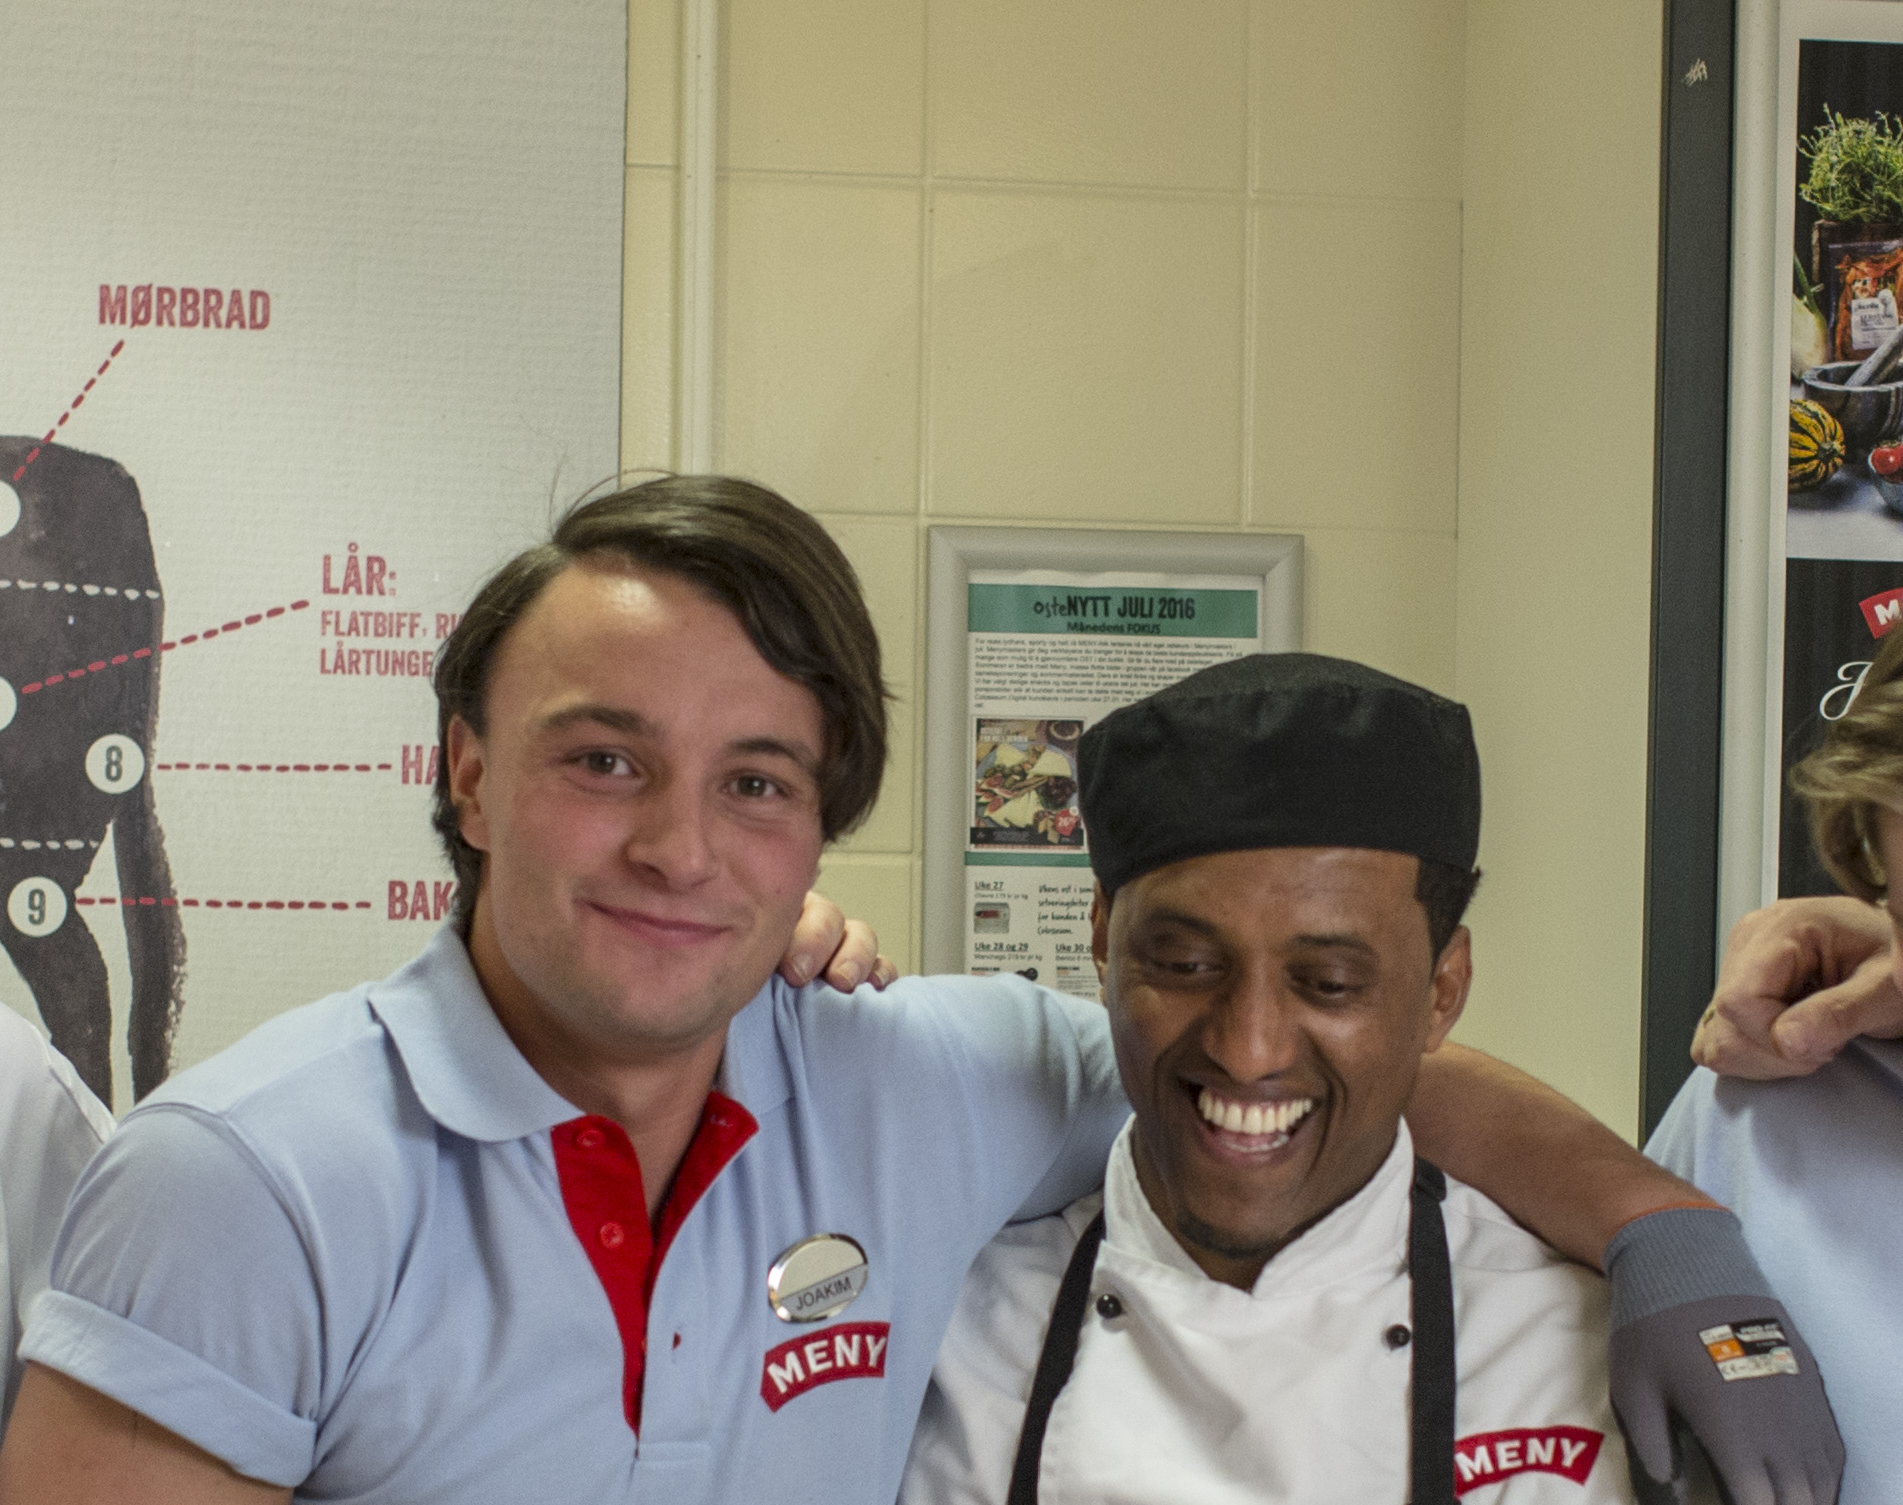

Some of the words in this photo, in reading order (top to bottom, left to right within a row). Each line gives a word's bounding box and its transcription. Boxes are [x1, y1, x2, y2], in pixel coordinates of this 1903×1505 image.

[98, 283, 272, 331] MØRBRAD
[322, 541, 397, 597] LÅR:
[320, 609, 428, 639] FLATBIFF,
[1118, 597, 1154, 619] JULI
[1158, 597, 1196, 620] 2016
[319, 639, 434, 677] LÅRTUNGE
[105, 746, 124, 783] 8
[993, 881, 1004, 890] 27
[28, 888, 46, 926] 9
[795, 1277, 852, 1311] JOAKIM
[767, 1334, 888, 1394] MENY
[1455, 1437, 1588, 1483] MENY
